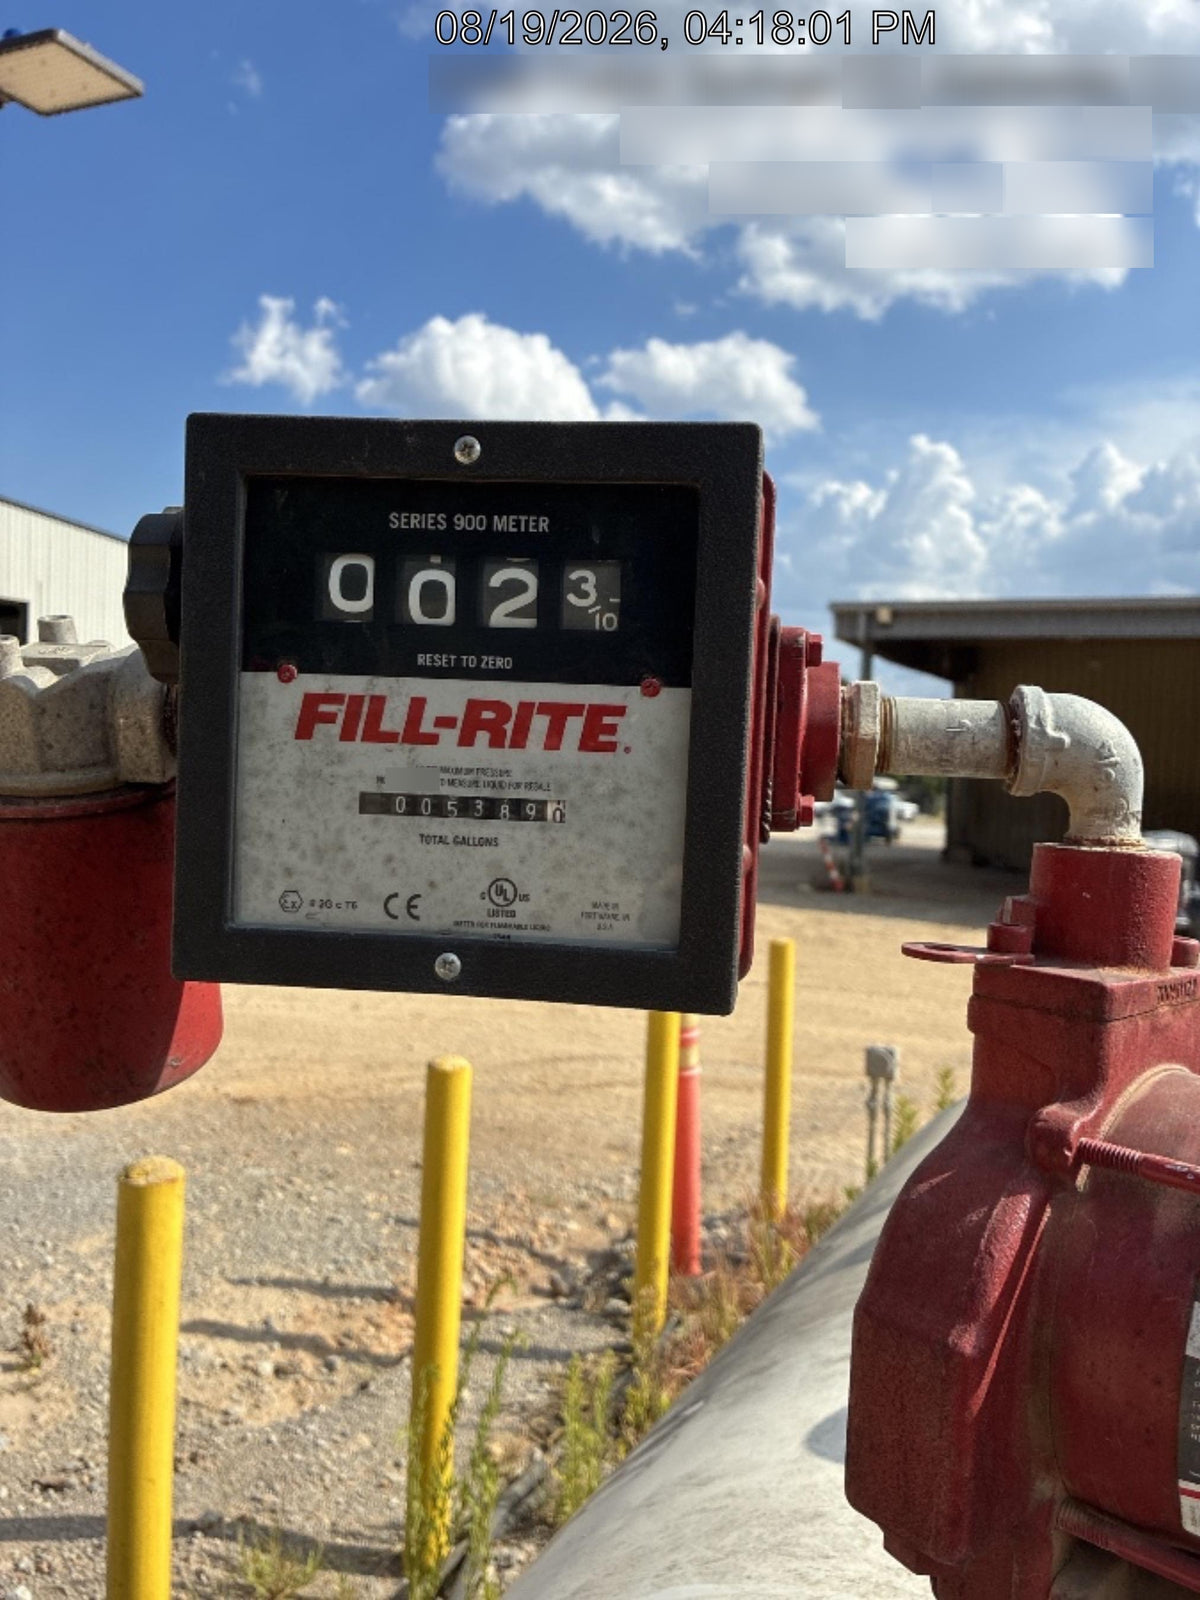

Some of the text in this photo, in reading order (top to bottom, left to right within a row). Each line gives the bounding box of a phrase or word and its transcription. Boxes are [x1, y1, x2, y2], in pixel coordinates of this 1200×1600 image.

[388, 512, 550, 533] SERIES 900 METER
[417, 653, 513, 669] RESET TO ZERO
[294, 692, 628, 753] FILL-RITE
[418, 833, 499, 847] TOTAL GALLONS
[384, 891, 422, 921] CE
[487, 908, 516, 918] LISTED
